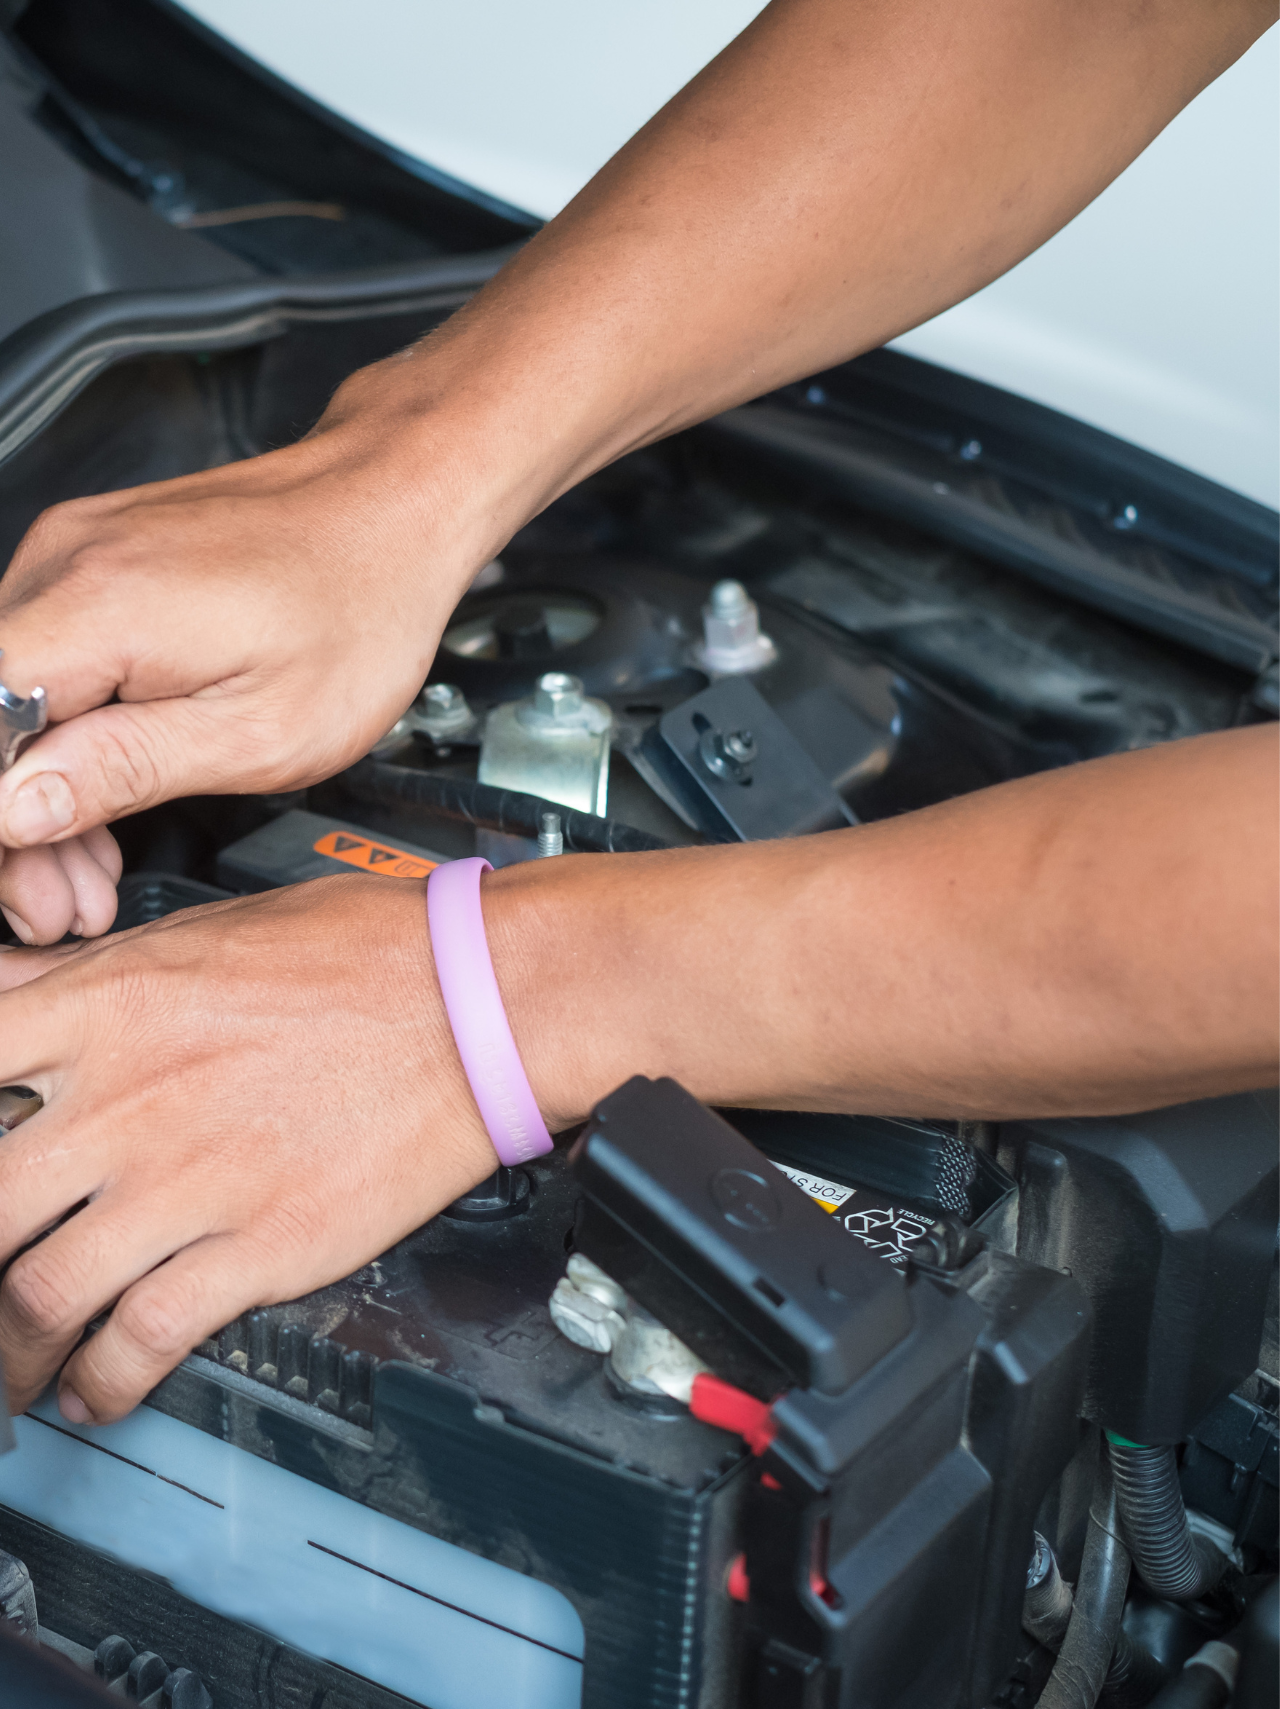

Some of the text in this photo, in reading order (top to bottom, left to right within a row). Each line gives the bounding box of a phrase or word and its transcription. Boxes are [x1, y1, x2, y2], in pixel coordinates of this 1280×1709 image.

[809, 1183, 847, 1201] FOR
[896, 1208, 935, 1226] RECYCLE
[889, 1254, 909, 1264] EAD
